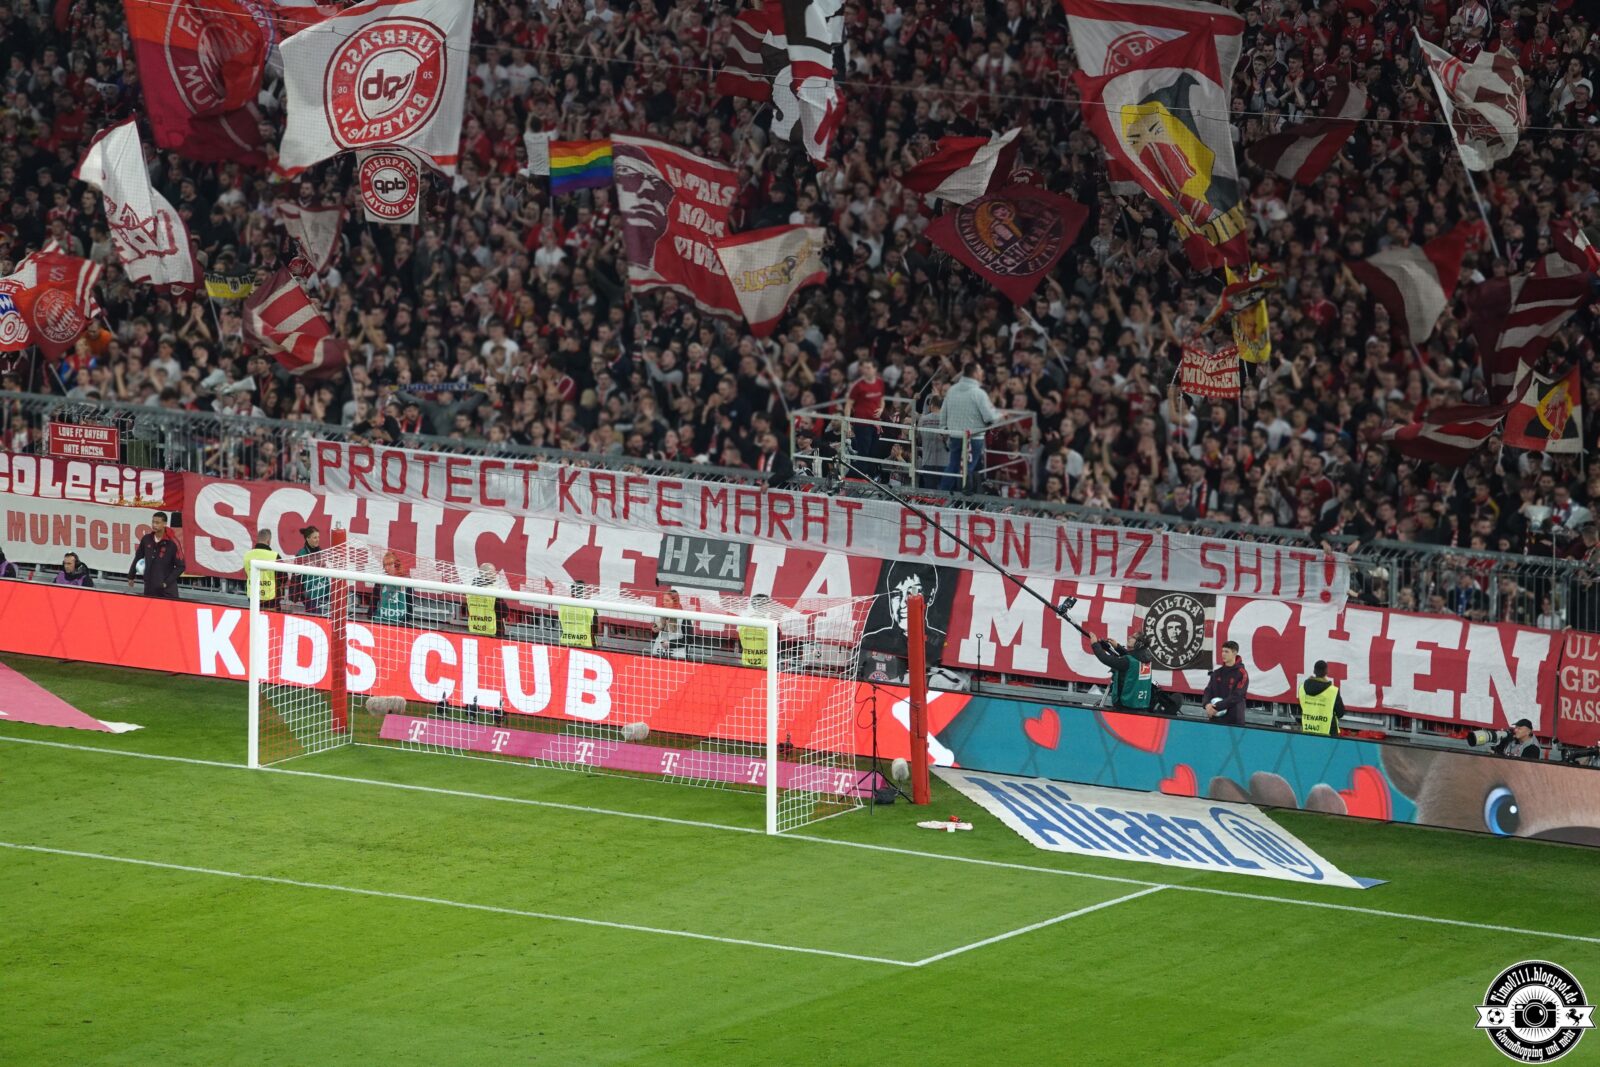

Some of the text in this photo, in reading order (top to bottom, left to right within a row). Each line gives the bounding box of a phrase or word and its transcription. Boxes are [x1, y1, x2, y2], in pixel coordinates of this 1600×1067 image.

[364, 190, 400, 215] BAYERN
[665, 164, 738, 208] UTRAS
[58, 426, 108, 440] LOVE FC BAYERN
[316, 441, 1338, 603] PROTECT KAFE MARAT BURN NAZI SHIT!
[1154, 596, 1202, 617] ULTRA
[196, 608, 614, 721] KIDS CLUB
[957, 570, 1552, 732] MÜCHEN
[1565, 632, 1600, 661] UL
[1137, 690, 1148, 700] 21
[963, 775, 1267, 870] Allianz
